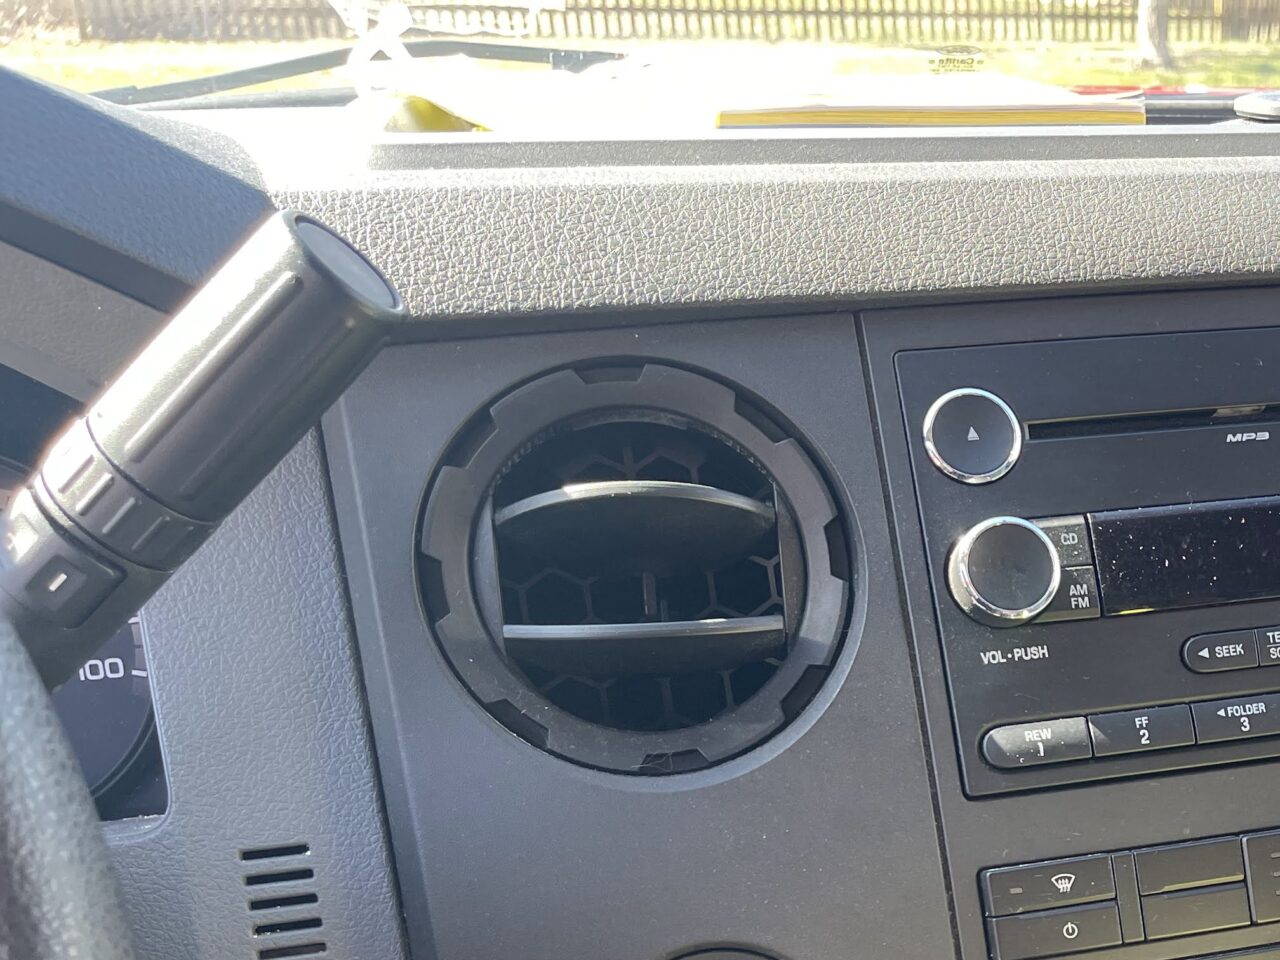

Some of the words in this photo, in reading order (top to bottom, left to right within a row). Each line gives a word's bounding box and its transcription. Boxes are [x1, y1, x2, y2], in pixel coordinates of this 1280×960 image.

[1226, 431, 1270, 442] MP3
[1060, 533, 1078, 545] CD
[1069, 584, 1088, 597] AM
[1071, 597, 1090, 609] FM
[1215, 644, 1245, 658] SEEK
[1227, 702, 1267, 717] FOLDER
[1135, 716, 1149, 728] FF
[1240, 717, 1251, 732] 3
[1024, 728, 1052, 742] REW
[1140, 729, 1150, 745] 2
